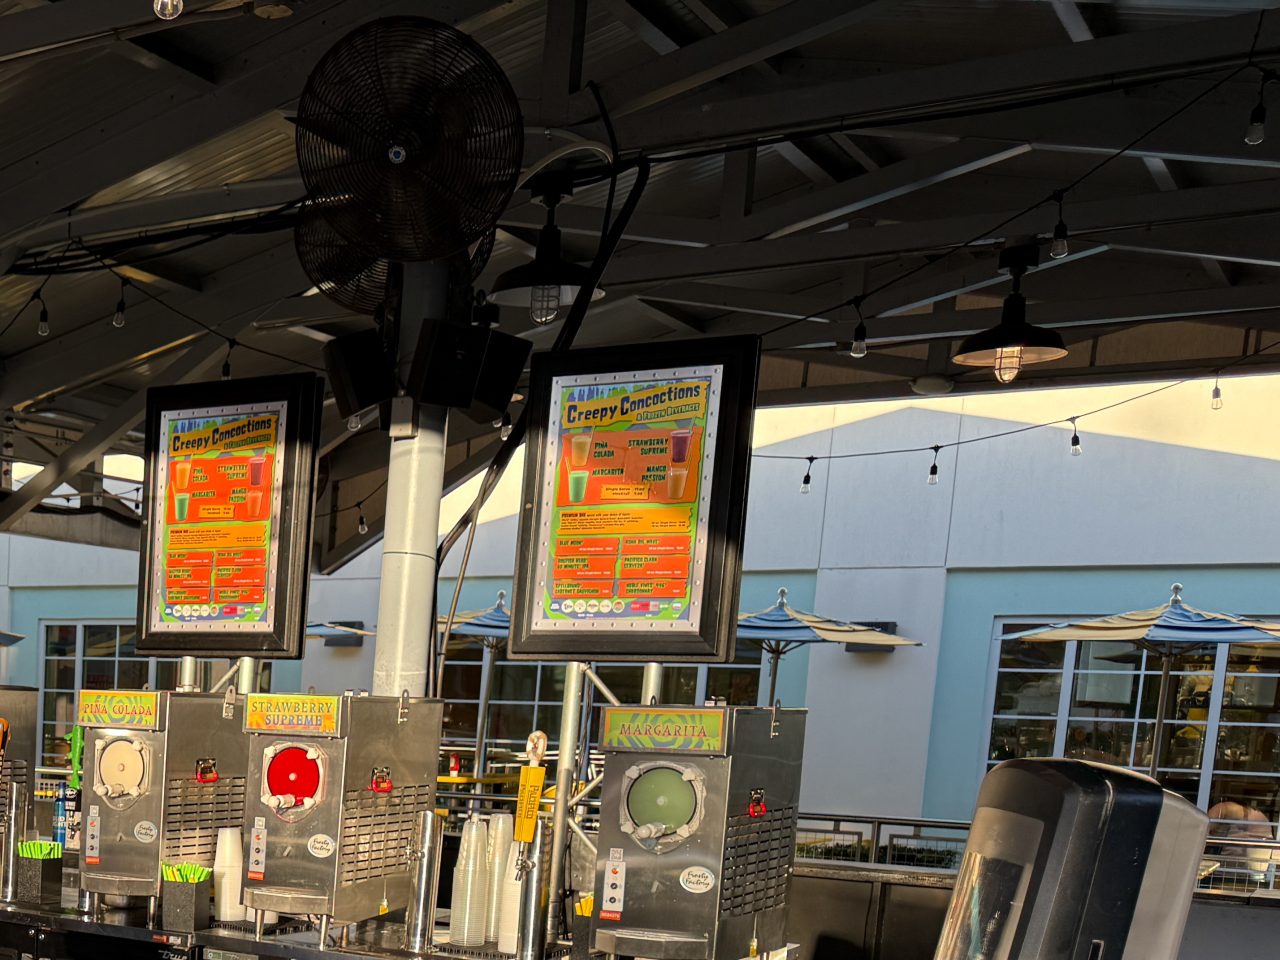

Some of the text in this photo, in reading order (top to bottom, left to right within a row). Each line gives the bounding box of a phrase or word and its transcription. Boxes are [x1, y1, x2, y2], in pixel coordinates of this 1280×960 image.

[567, 385, 701, 423] Creepy Concoctions
[172, 435, 210, 452] Creepy
[212, 418, 272, 445] Concoctions
[628, 438, 669, 447] STRAWBERRY
[640, 447, 668, 456] SUPREME
[112, 704, 152, 716] COLADA
[251, 701, 333, 713] STRAWBERRY
[265, 714, 322, 726] SUPREME
[620, 723, 707, 737] MARGARITA
[687, 870, 709, 880] Frosty
[685, 878, 710, 889] Factory
